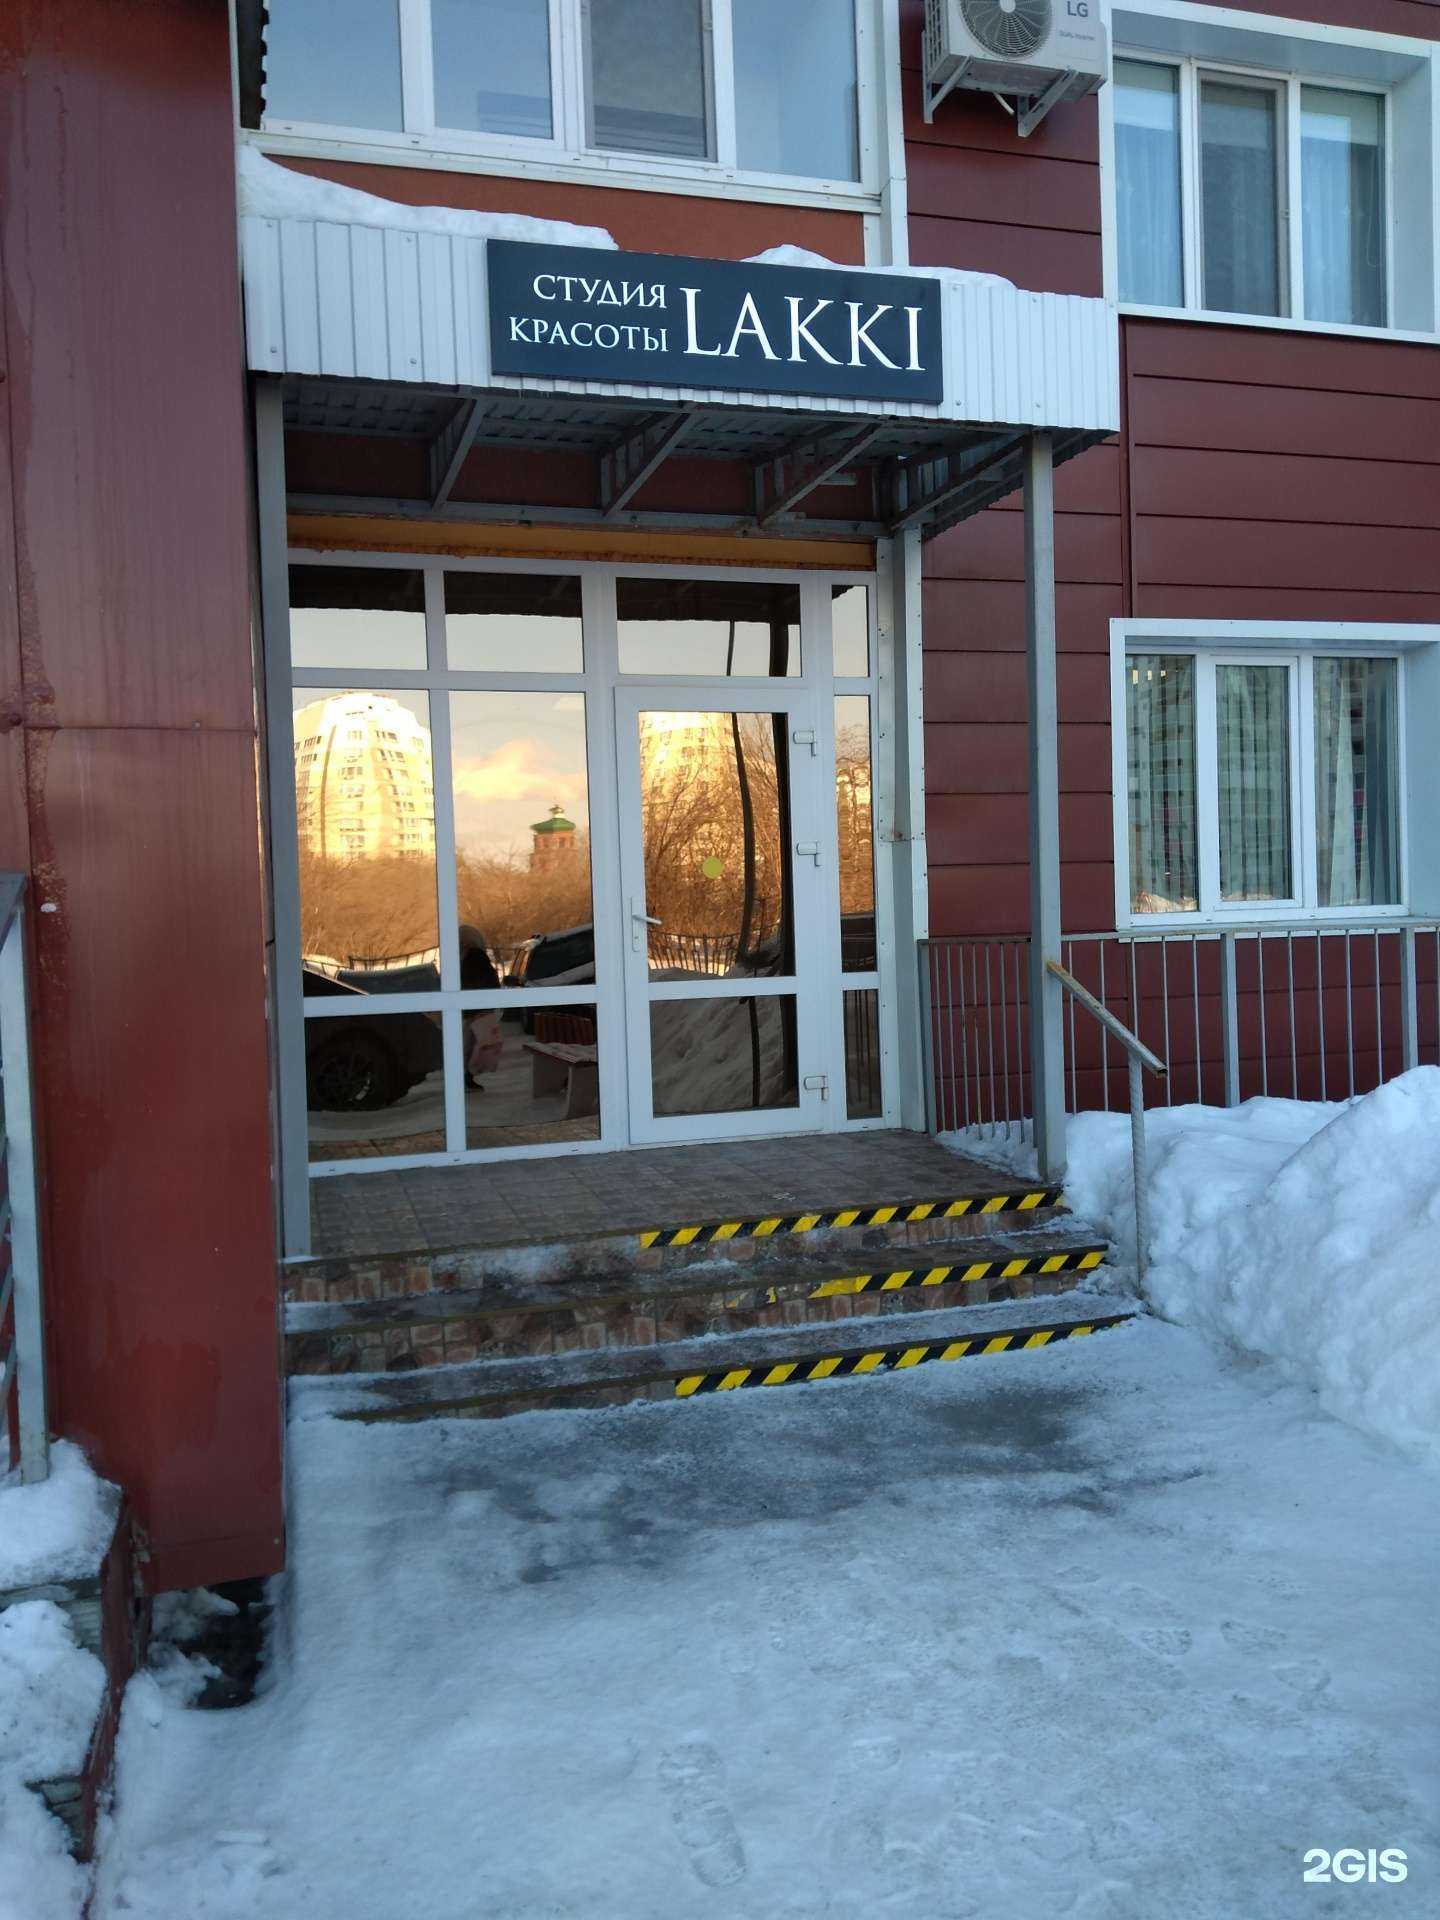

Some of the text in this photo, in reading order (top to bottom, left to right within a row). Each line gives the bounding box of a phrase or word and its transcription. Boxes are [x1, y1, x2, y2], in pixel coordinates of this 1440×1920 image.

[1067, 0, 1089, 18] LG
[532, 274, 668, 309] СТУДИЯ
[508, 315, 670, 352] КРАСОТЫ
[679, 286, 927, 372] LAKKI
